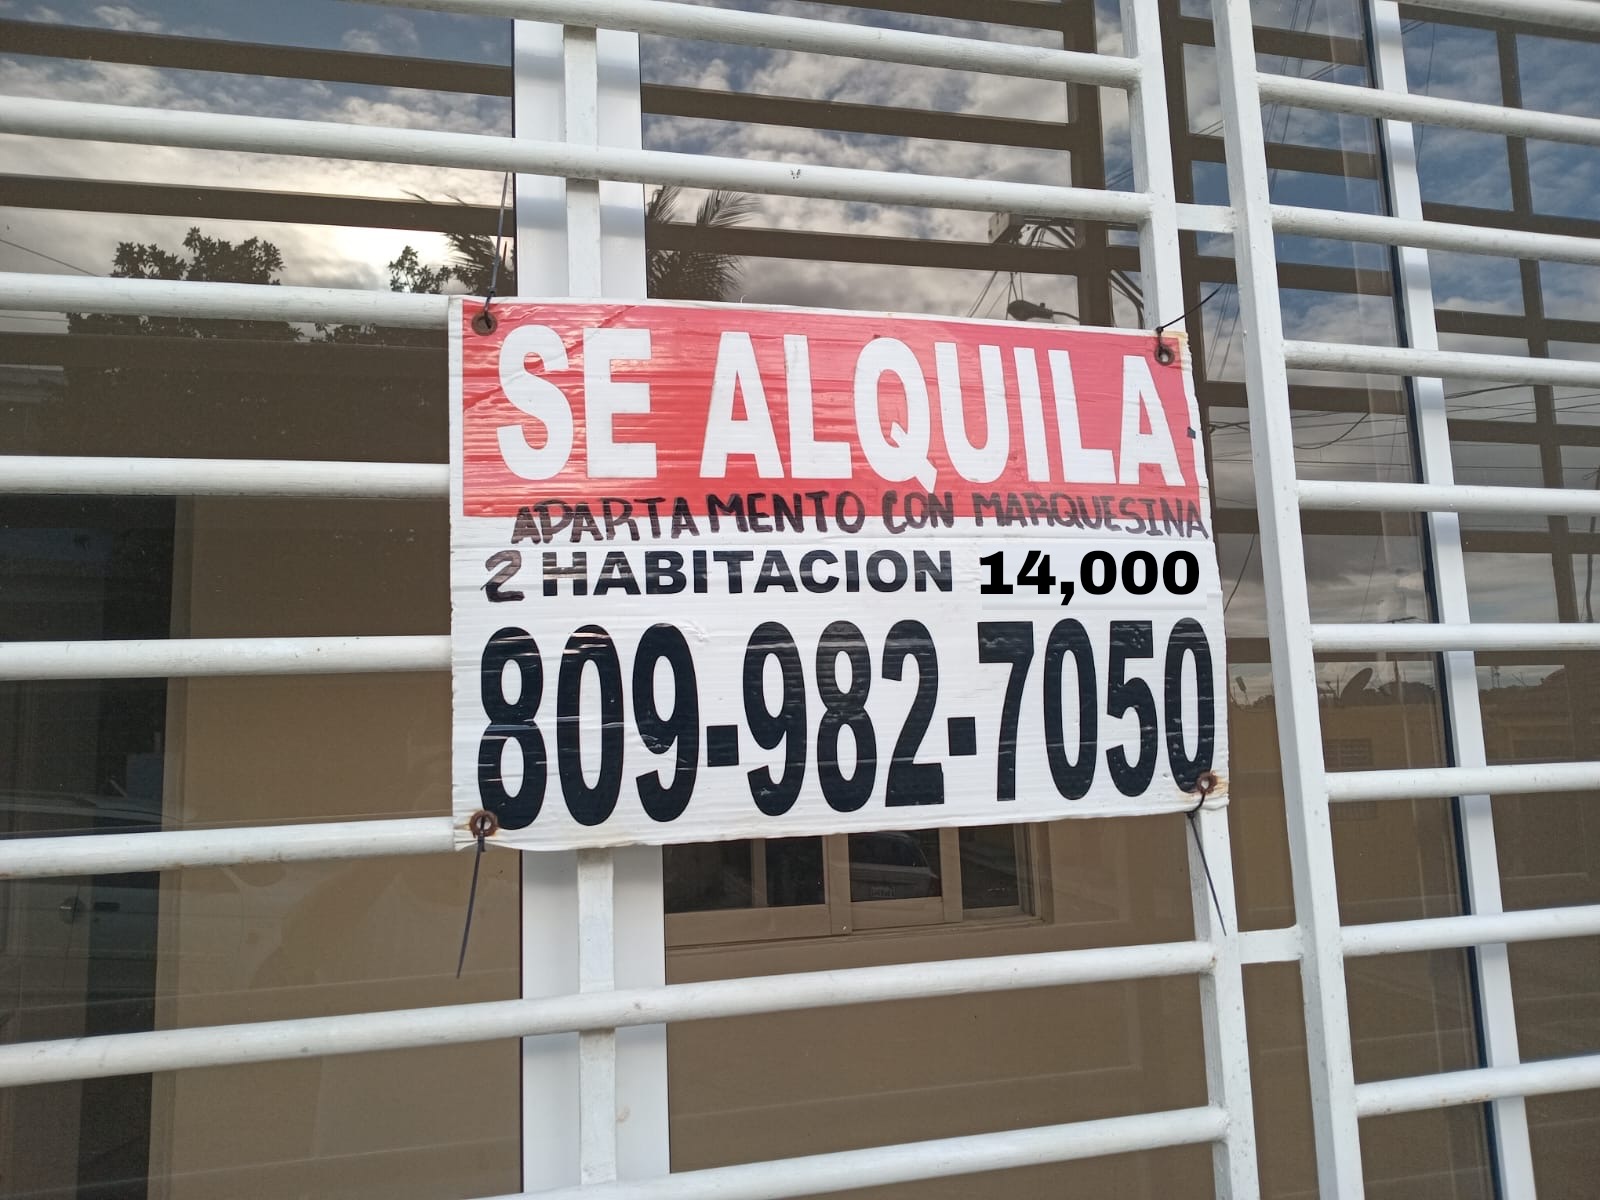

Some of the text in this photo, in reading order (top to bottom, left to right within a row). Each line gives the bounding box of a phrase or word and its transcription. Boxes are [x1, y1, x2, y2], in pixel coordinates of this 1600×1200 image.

[497, 325, 1186, 493] SE ALQUILA
[511, 489, 1209, 544] APARTAMENTO CON MARQUESINA
[480, 549, 953, 602] 2 HABITACION
[478, 617, 1215, 830] 809-982-7050
